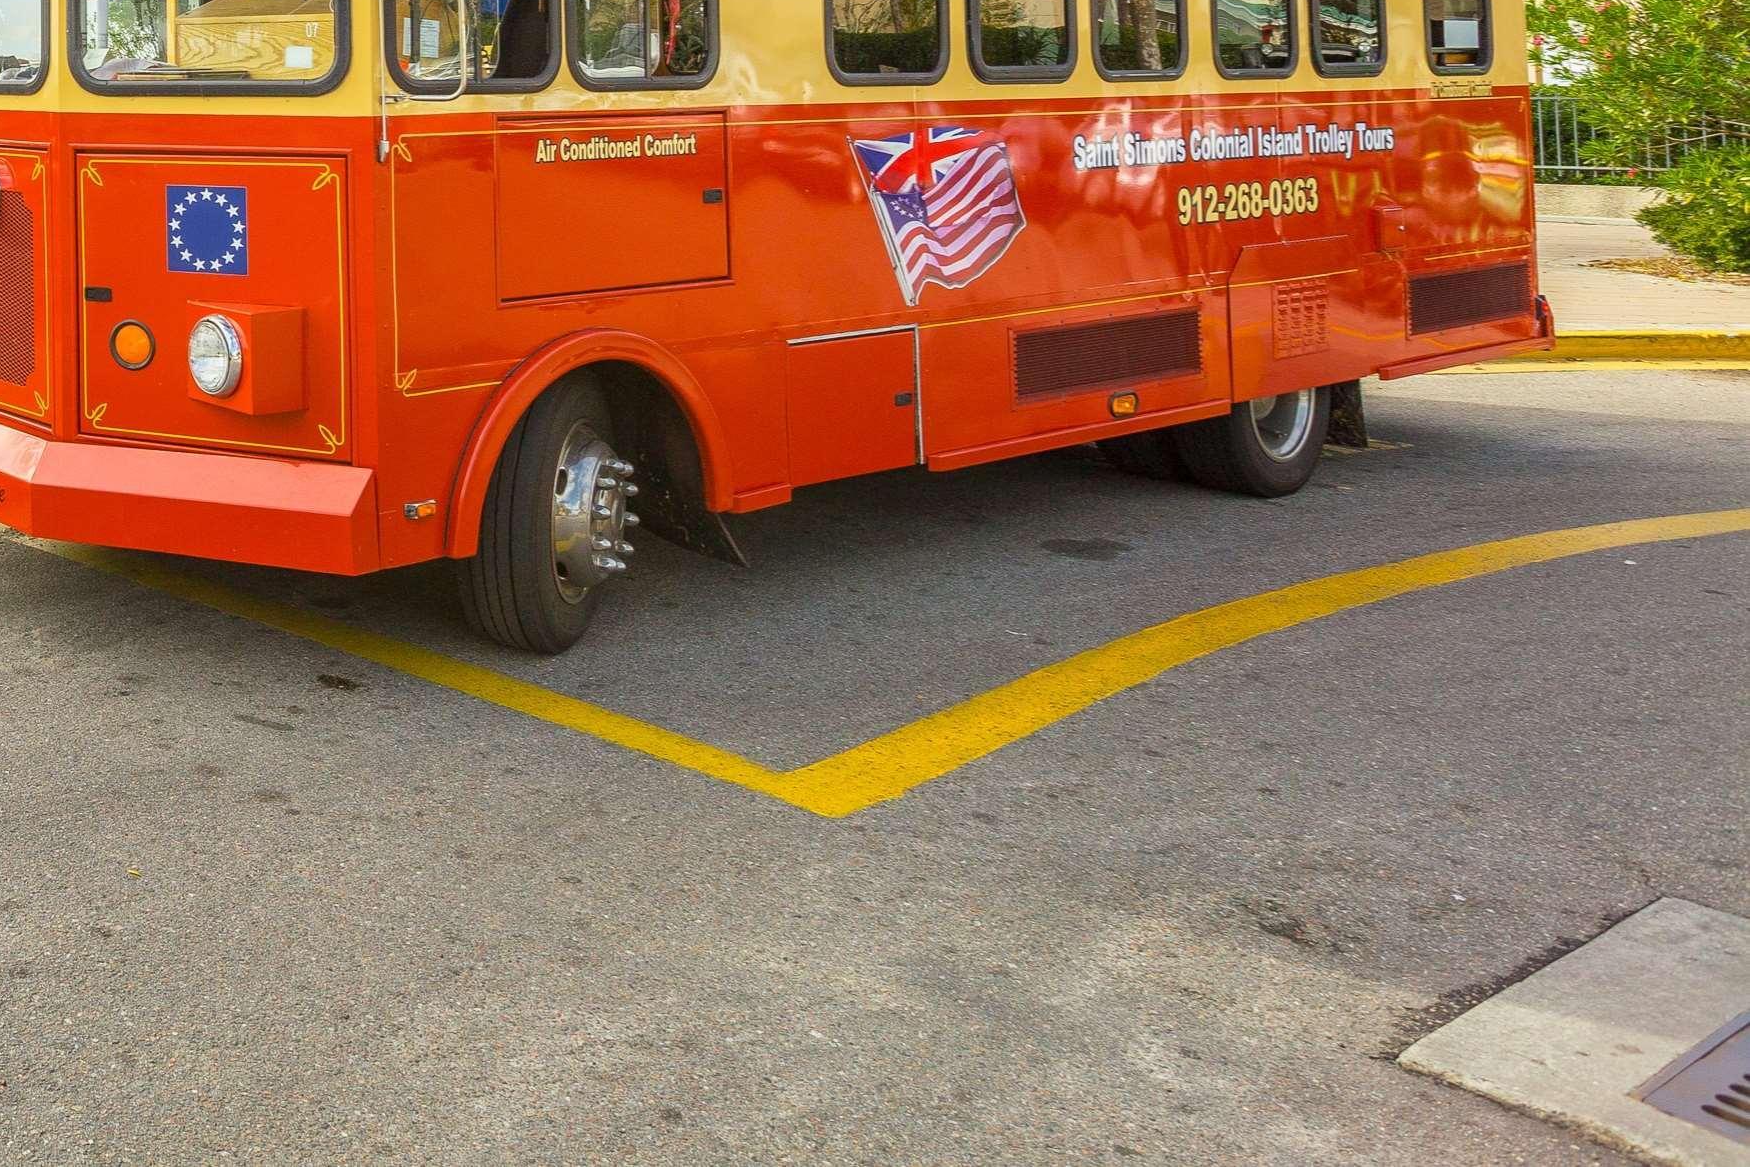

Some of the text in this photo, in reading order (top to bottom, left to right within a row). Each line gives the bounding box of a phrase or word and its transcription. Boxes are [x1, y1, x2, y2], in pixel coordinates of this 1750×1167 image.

[536, 133, 697, 163] Air Conditioned Comfort
[1073, 122, 1394, 169] Saint Simons Colonial Island Trolley Tours
[1177, 177, 1319, 226] 912-268-0363
